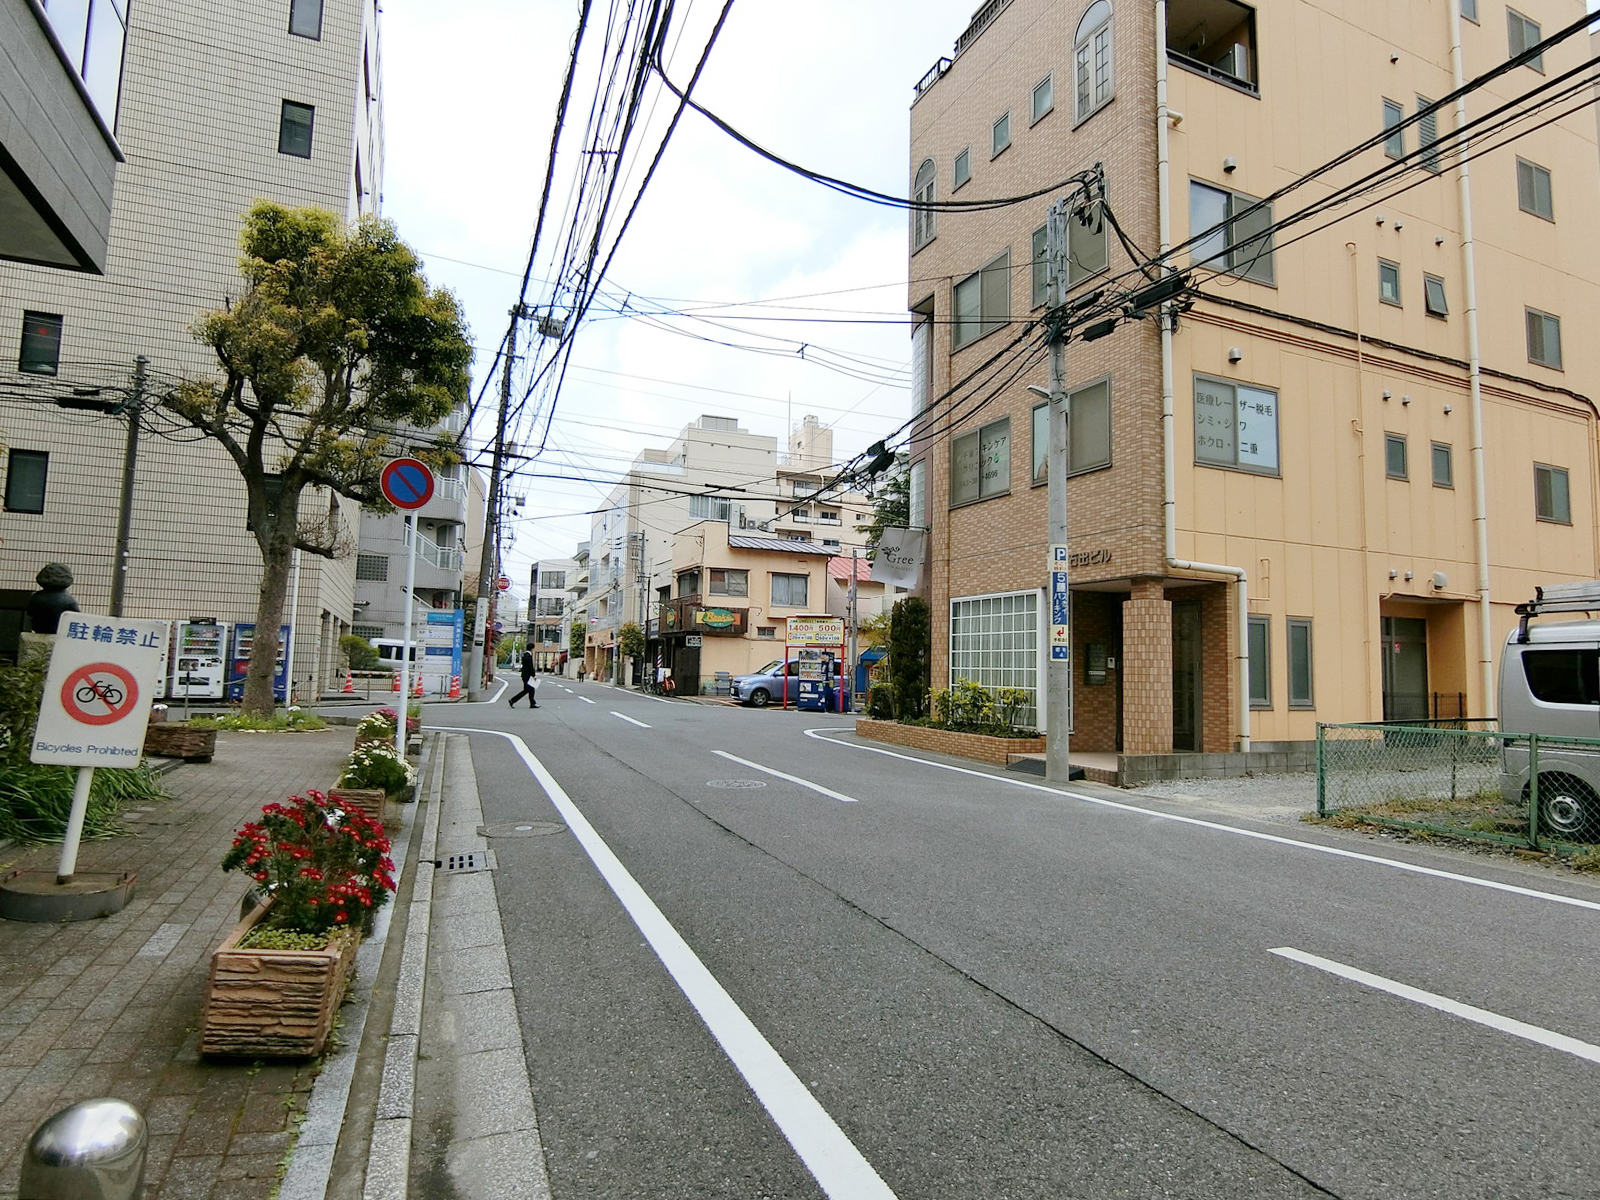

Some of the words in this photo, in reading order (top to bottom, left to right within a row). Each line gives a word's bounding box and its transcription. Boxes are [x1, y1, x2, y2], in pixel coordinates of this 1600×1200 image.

[1196, 392, 1273, 417] 医療レーザー脱毛
[1197, 413, 1247, 431] シミ・シワ
[886, 553, 914, 565] Gree
[66, 621, 160, 649] 駐輪禁止
[36, 742, 82, 754] Bicycles
